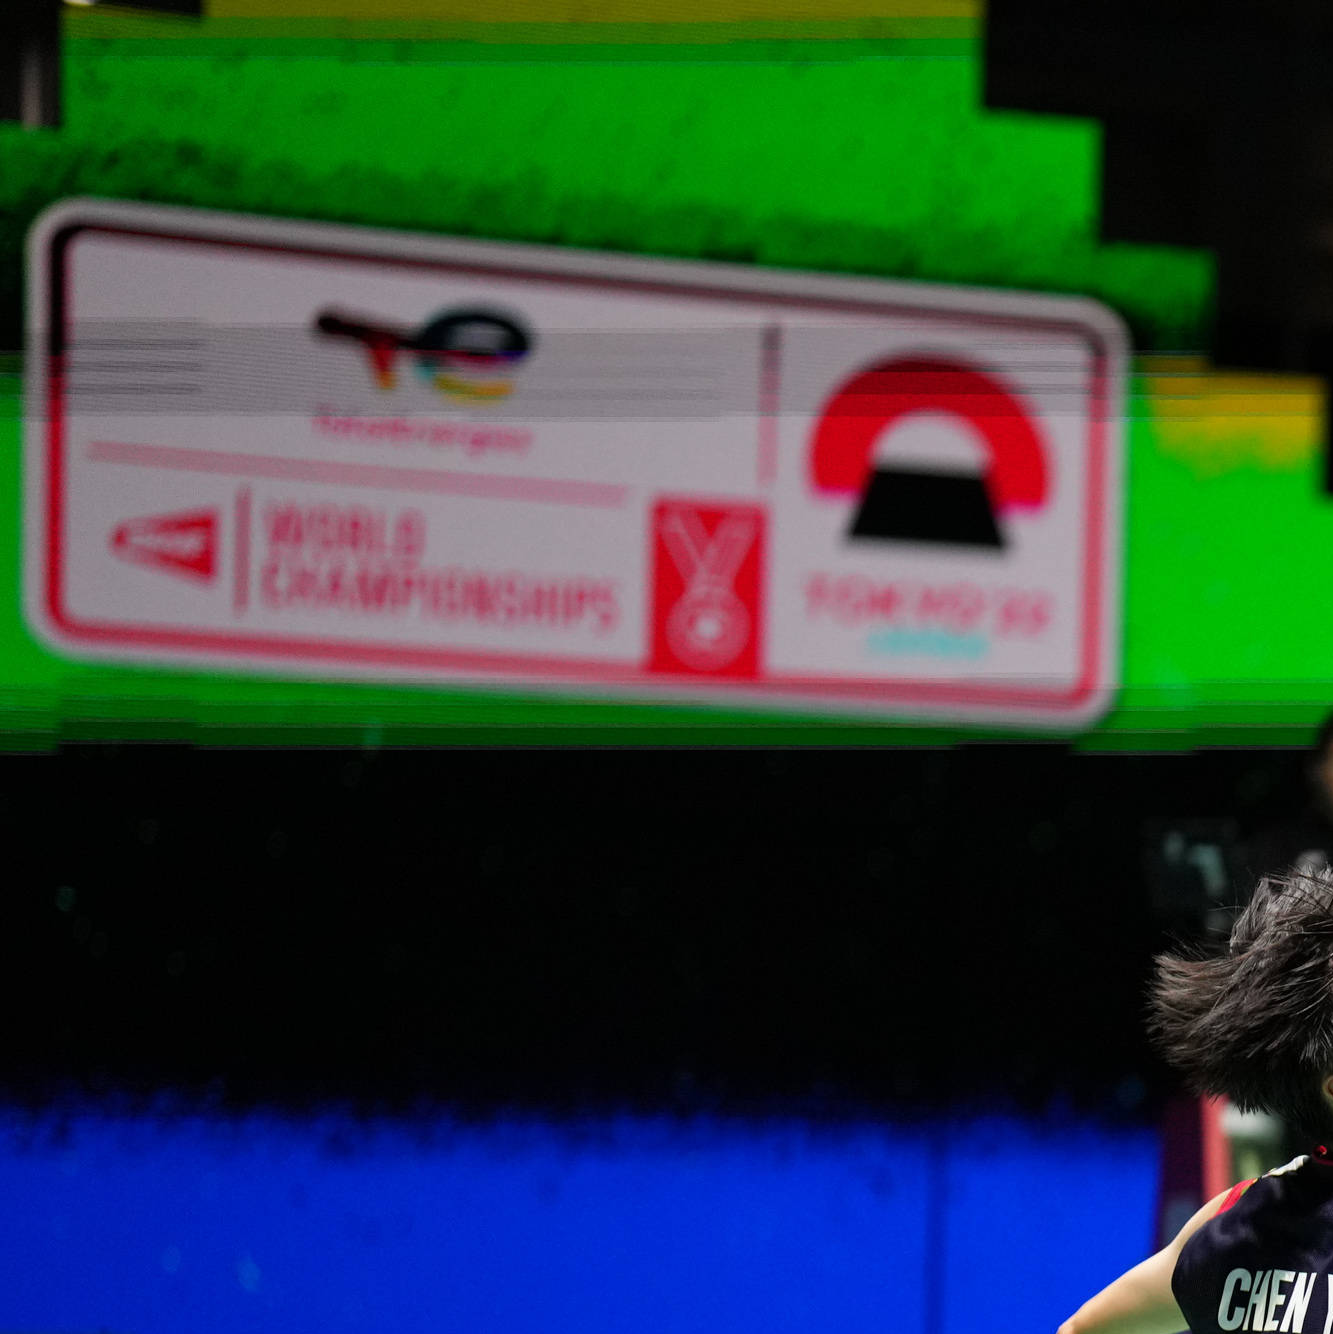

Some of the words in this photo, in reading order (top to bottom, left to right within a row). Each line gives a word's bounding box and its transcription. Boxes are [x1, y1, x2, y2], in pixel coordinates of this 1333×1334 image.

[263, 499, 427, 562] WORLD
[261, 558, 621, 634] CHAMPIONSHIPS
[1217, 1267, 1317, 1334] CHEN
